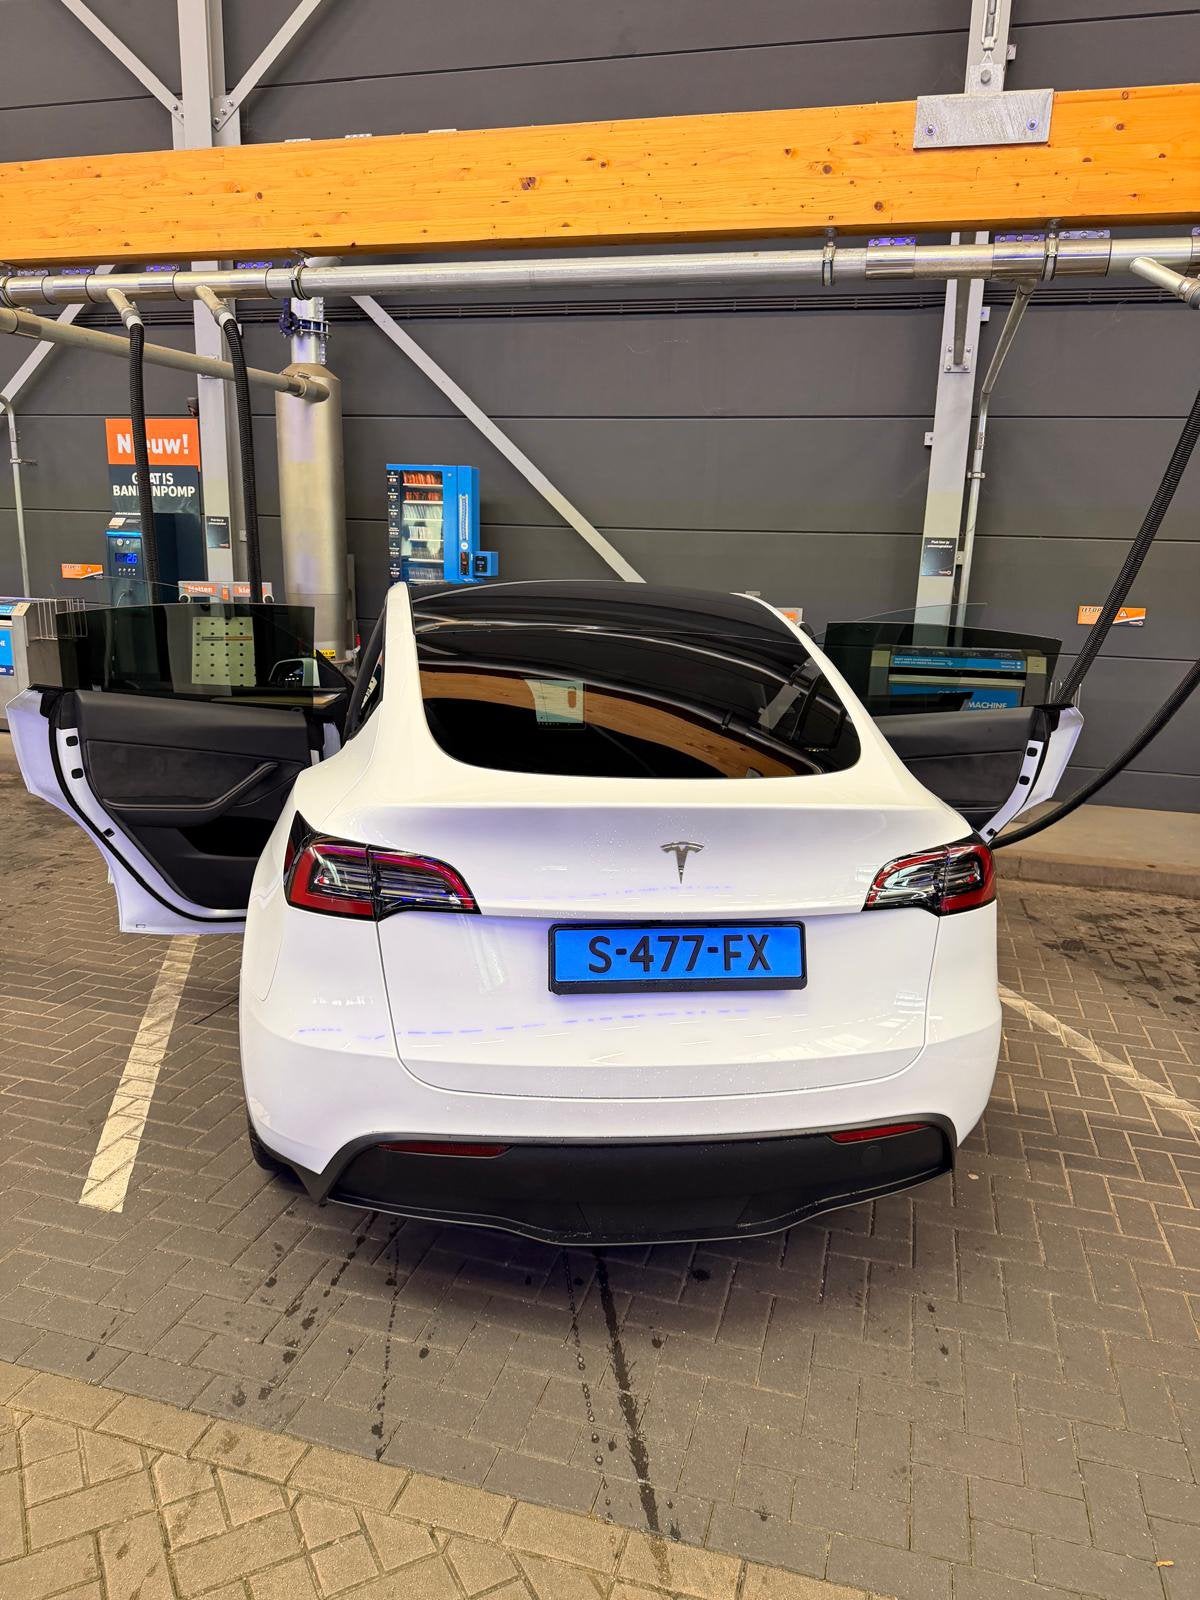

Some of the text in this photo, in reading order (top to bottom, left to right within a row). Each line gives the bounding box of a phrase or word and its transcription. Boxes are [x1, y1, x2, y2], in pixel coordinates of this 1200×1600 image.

[116, 433, 189, 455] Nuw!
[131, 472, 174, 485] GATIS
[112, 485, 196, 498] BANNPOMP
[588, 934, 772, 974] S-477-FX
